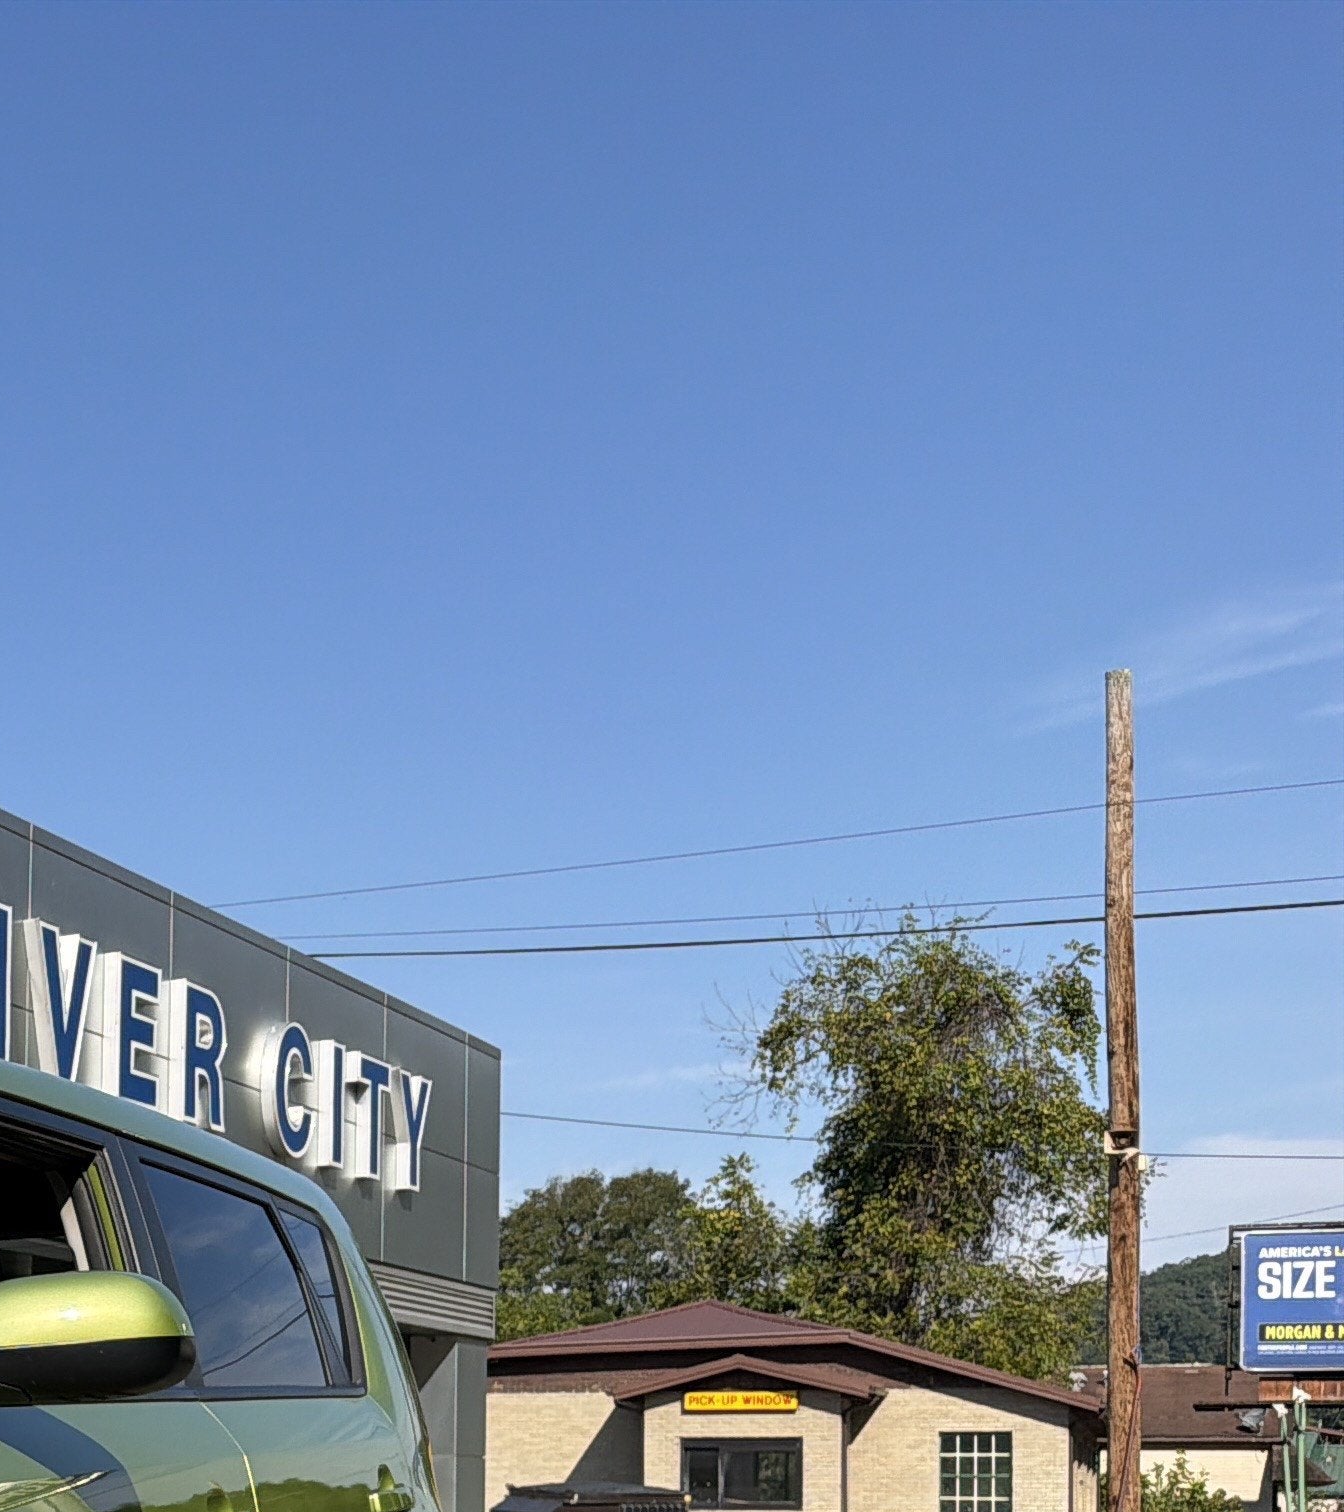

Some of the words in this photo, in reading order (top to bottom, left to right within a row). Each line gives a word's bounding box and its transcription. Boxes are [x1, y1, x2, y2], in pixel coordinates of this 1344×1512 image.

[264, 1021, 433, 1192] CITY
[1258, 1245, 1331, 1259] AMERICA'S
[1257, 1260, 1336, 1299] SIZE
[1265, 1325, 1321, 1340] MORGAN
[1325, 1324, 1335, 1339] &
[742, 1393, 794, 1406] WINDOW
